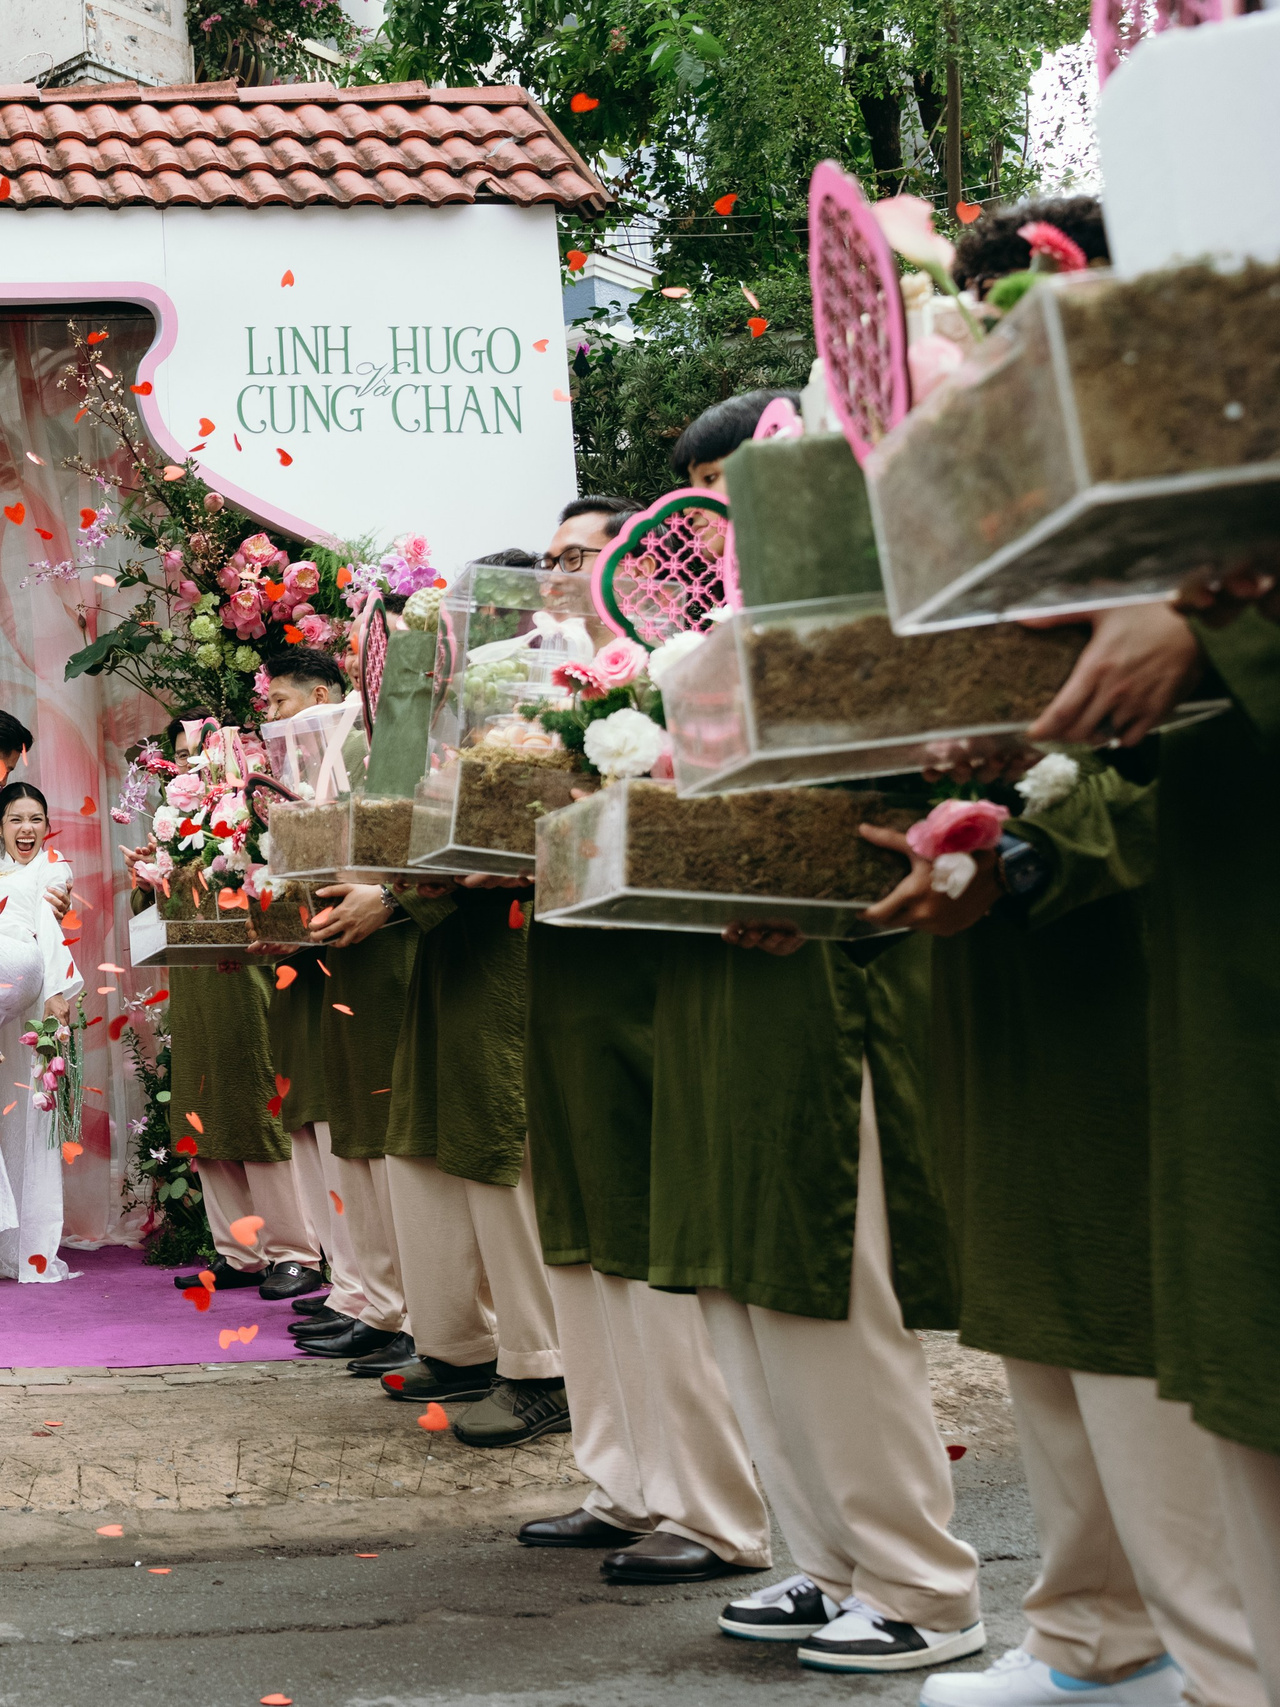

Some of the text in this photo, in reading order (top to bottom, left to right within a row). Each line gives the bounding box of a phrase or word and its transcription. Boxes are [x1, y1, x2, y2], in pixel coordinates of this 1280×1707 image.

[244, 325, 522, 377] LINH HUGO
[356, 361, 412, 399] Và
[236, 383, 523, 435] CUNG CHAN
